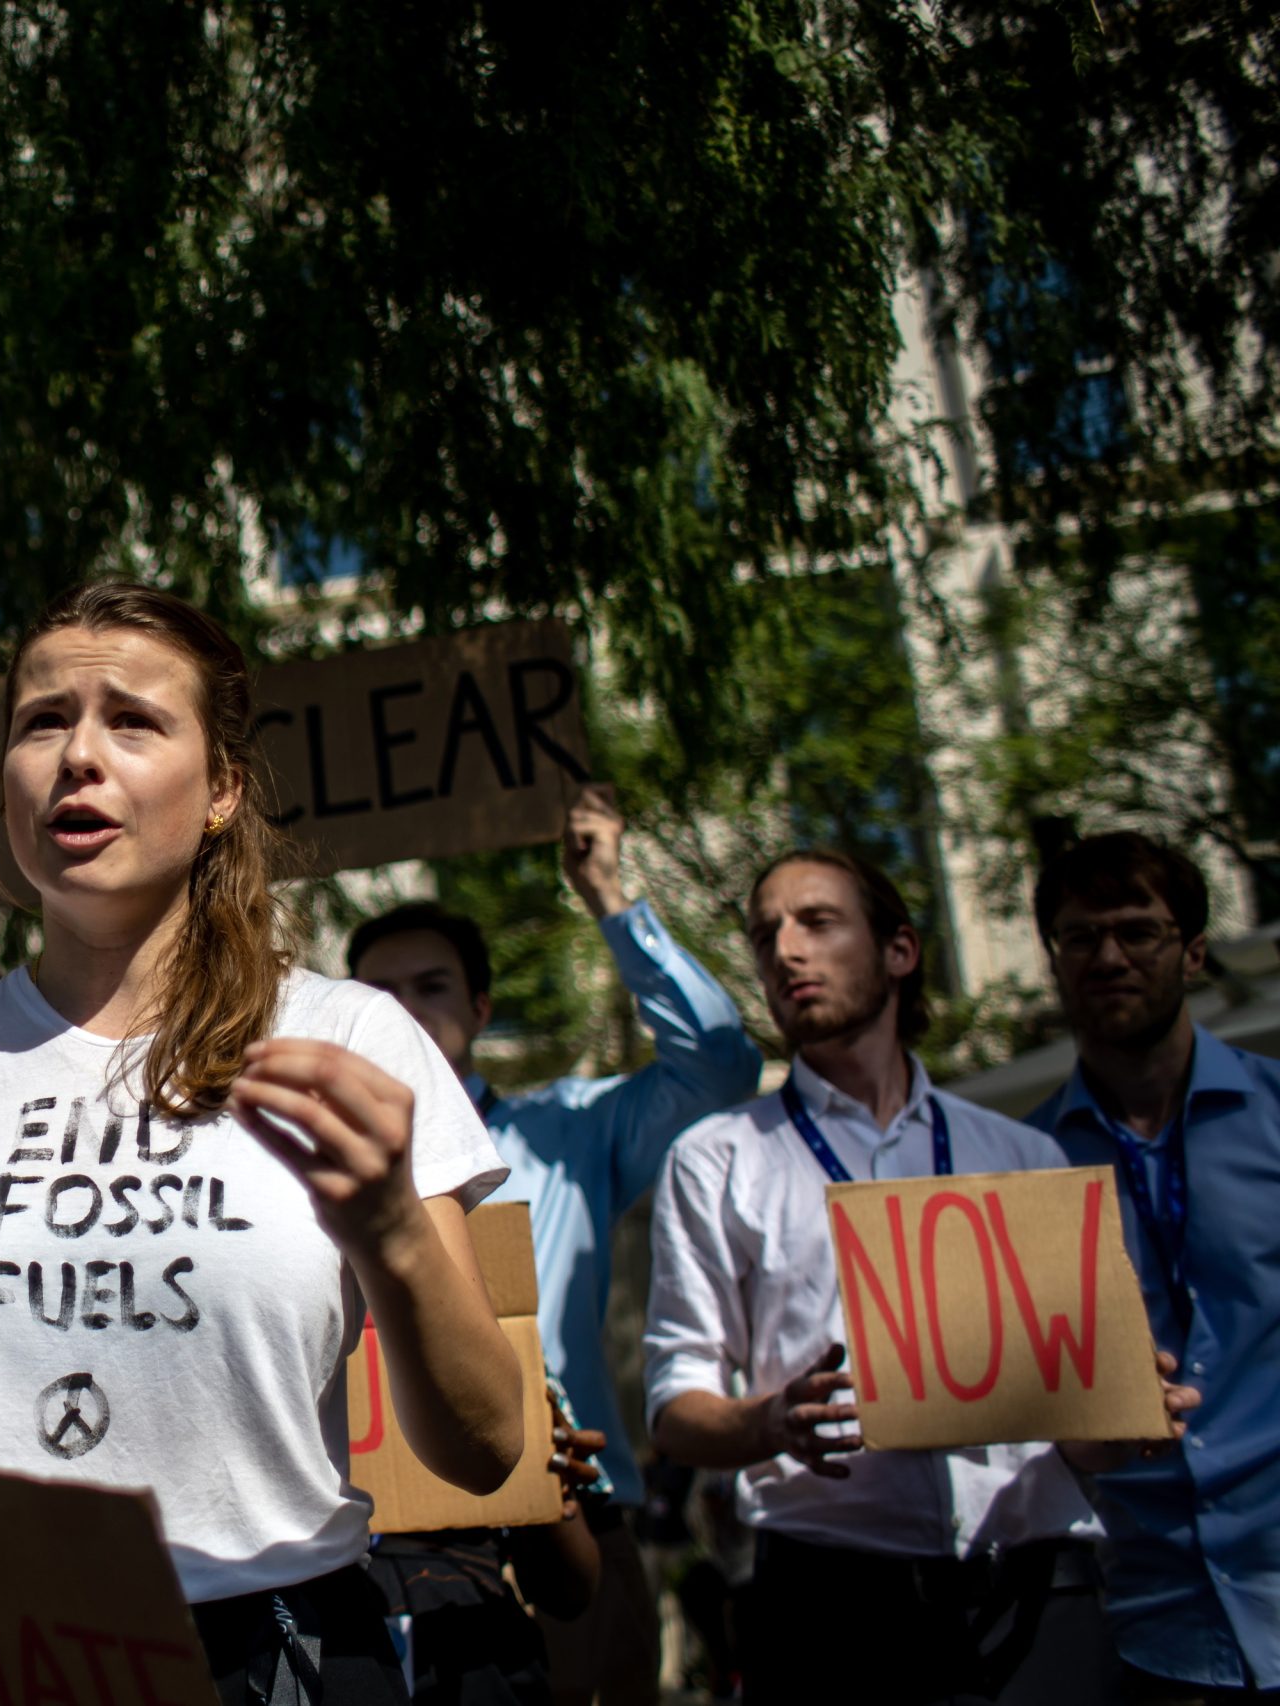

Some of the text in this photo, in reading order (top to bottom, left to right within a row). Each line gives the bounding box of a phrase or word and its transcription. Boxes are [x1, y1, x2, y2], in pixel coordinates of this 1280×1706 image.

[251, 659, 590, 826] CLEAR
[7, 1097, 194, 1165] END
[831, 1181, 1104, 1403] NOW
